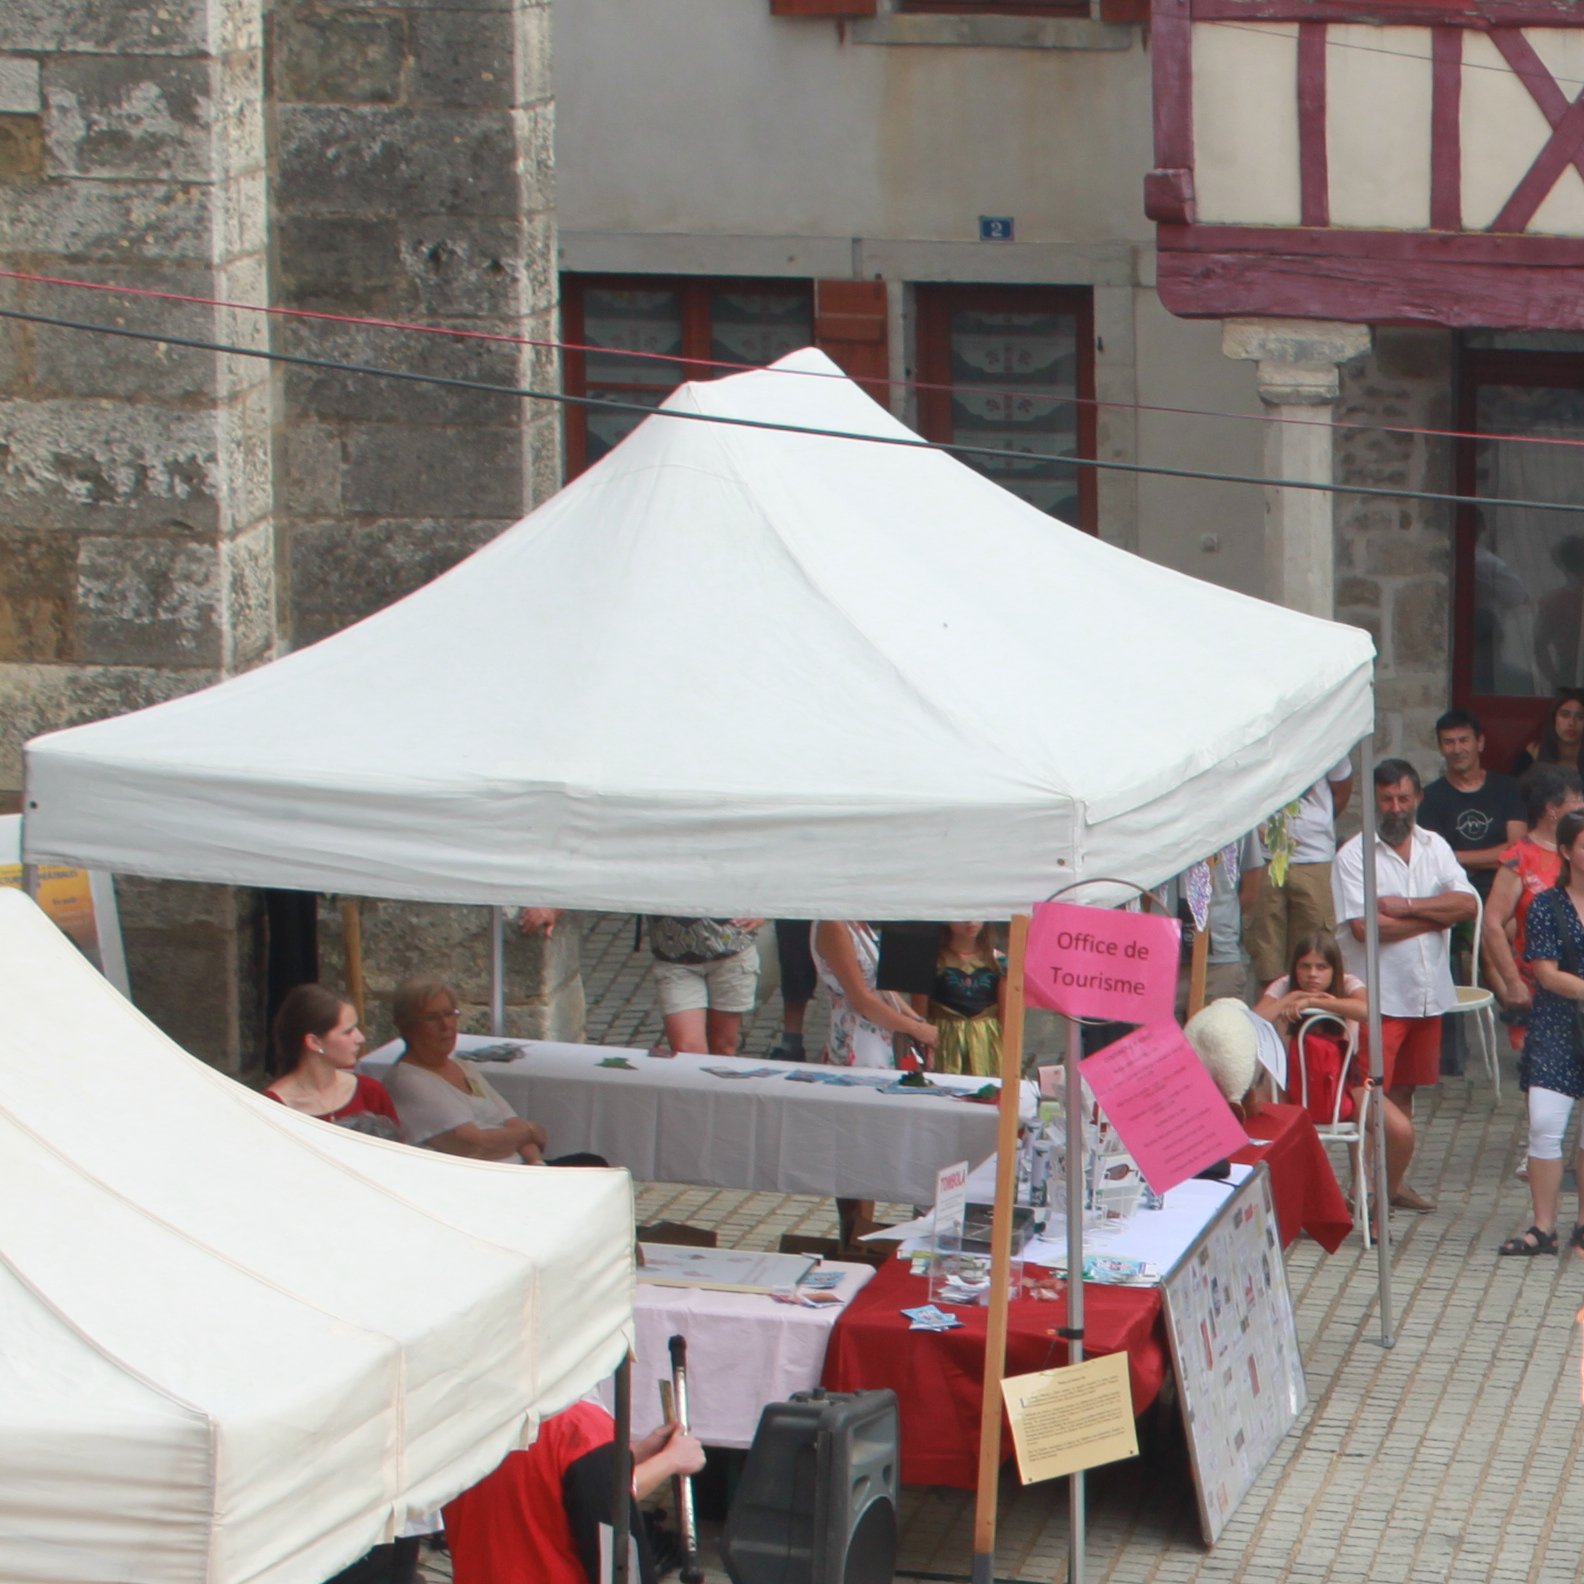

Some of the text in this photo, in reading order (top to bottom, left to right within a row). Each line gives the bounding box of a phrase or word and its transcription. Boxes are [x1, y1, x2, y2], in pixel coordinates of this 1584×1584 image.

[991, 221, 1003, 238] 2
[1057, 932, 1149, 960] Office de
[1050, 966, 1145, 995] Tourisme
